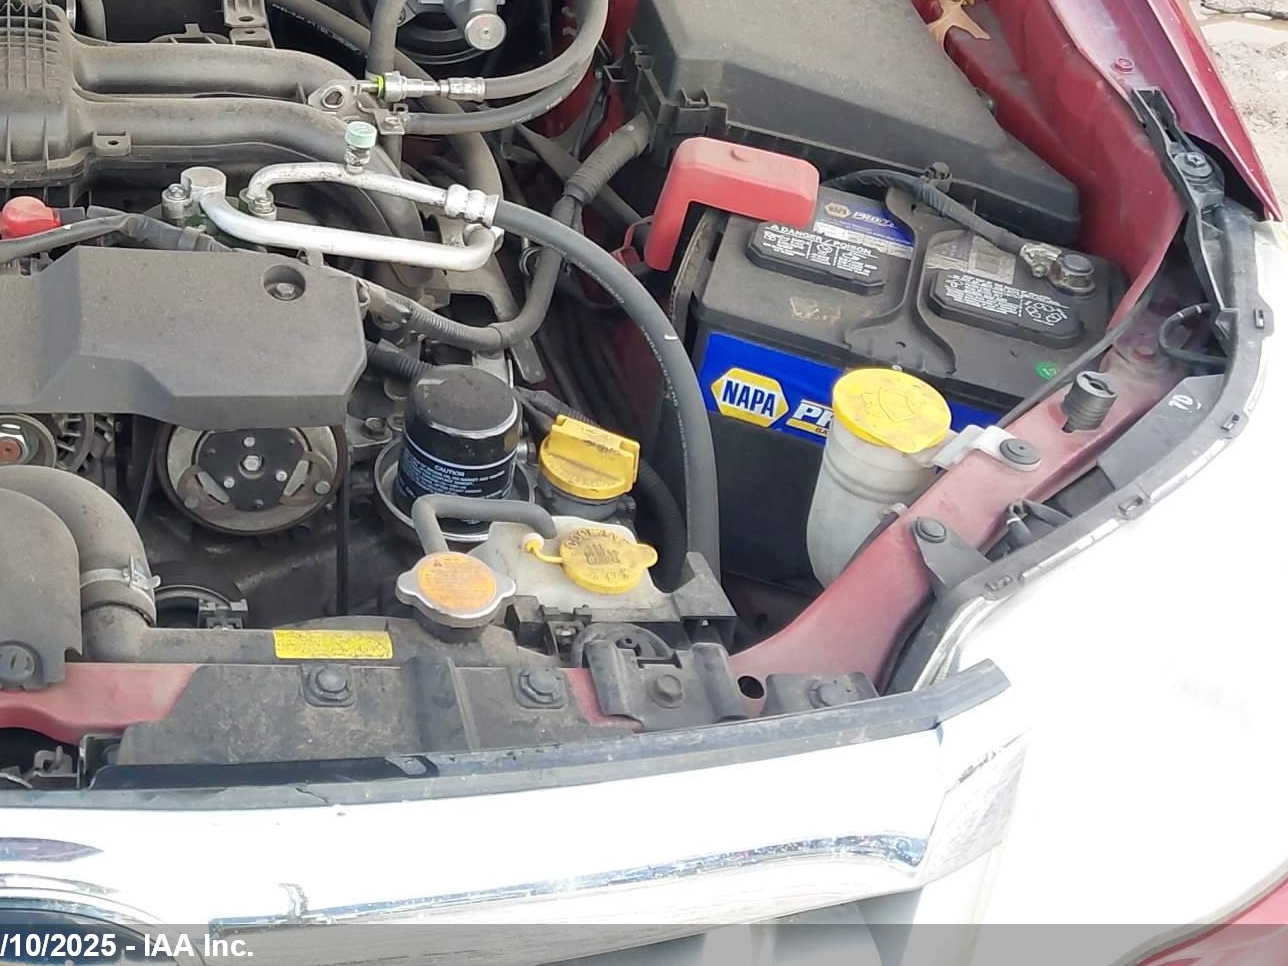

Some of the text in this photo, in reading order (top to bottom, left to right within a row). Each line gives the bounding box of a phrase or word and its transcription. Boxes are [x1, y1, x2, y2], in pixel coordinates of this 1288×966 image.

[781, 225, 824, 243] DANGER
[833, 240, 873, 257] POISON
[722, 379, 776, 418] NAPA
[434, 464, 465, 477] CAUTION
